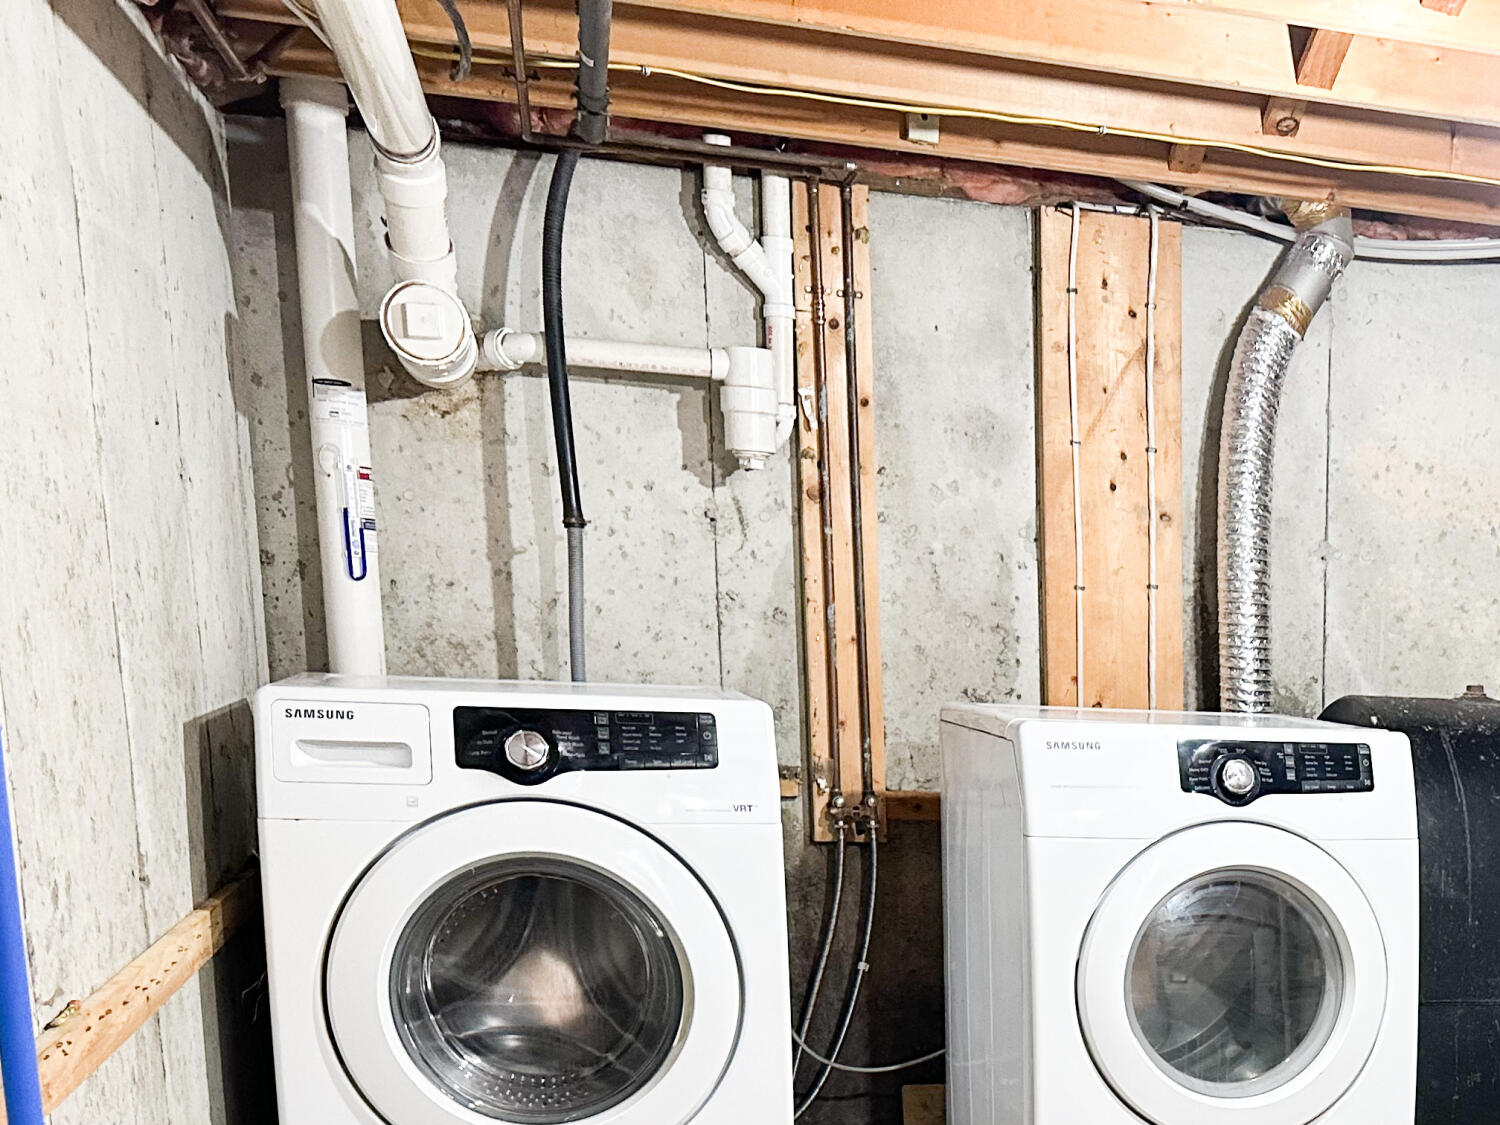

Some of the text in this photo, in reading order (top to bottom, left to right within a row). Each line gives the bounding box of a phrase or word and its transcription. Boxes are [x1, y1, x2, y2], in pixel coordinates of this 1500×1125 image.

[284, 708, 354, 720] SAMSUNG
[1045, 741, 1101, 750] SAMSUNG
[732, 804, 753, 812] VRT
